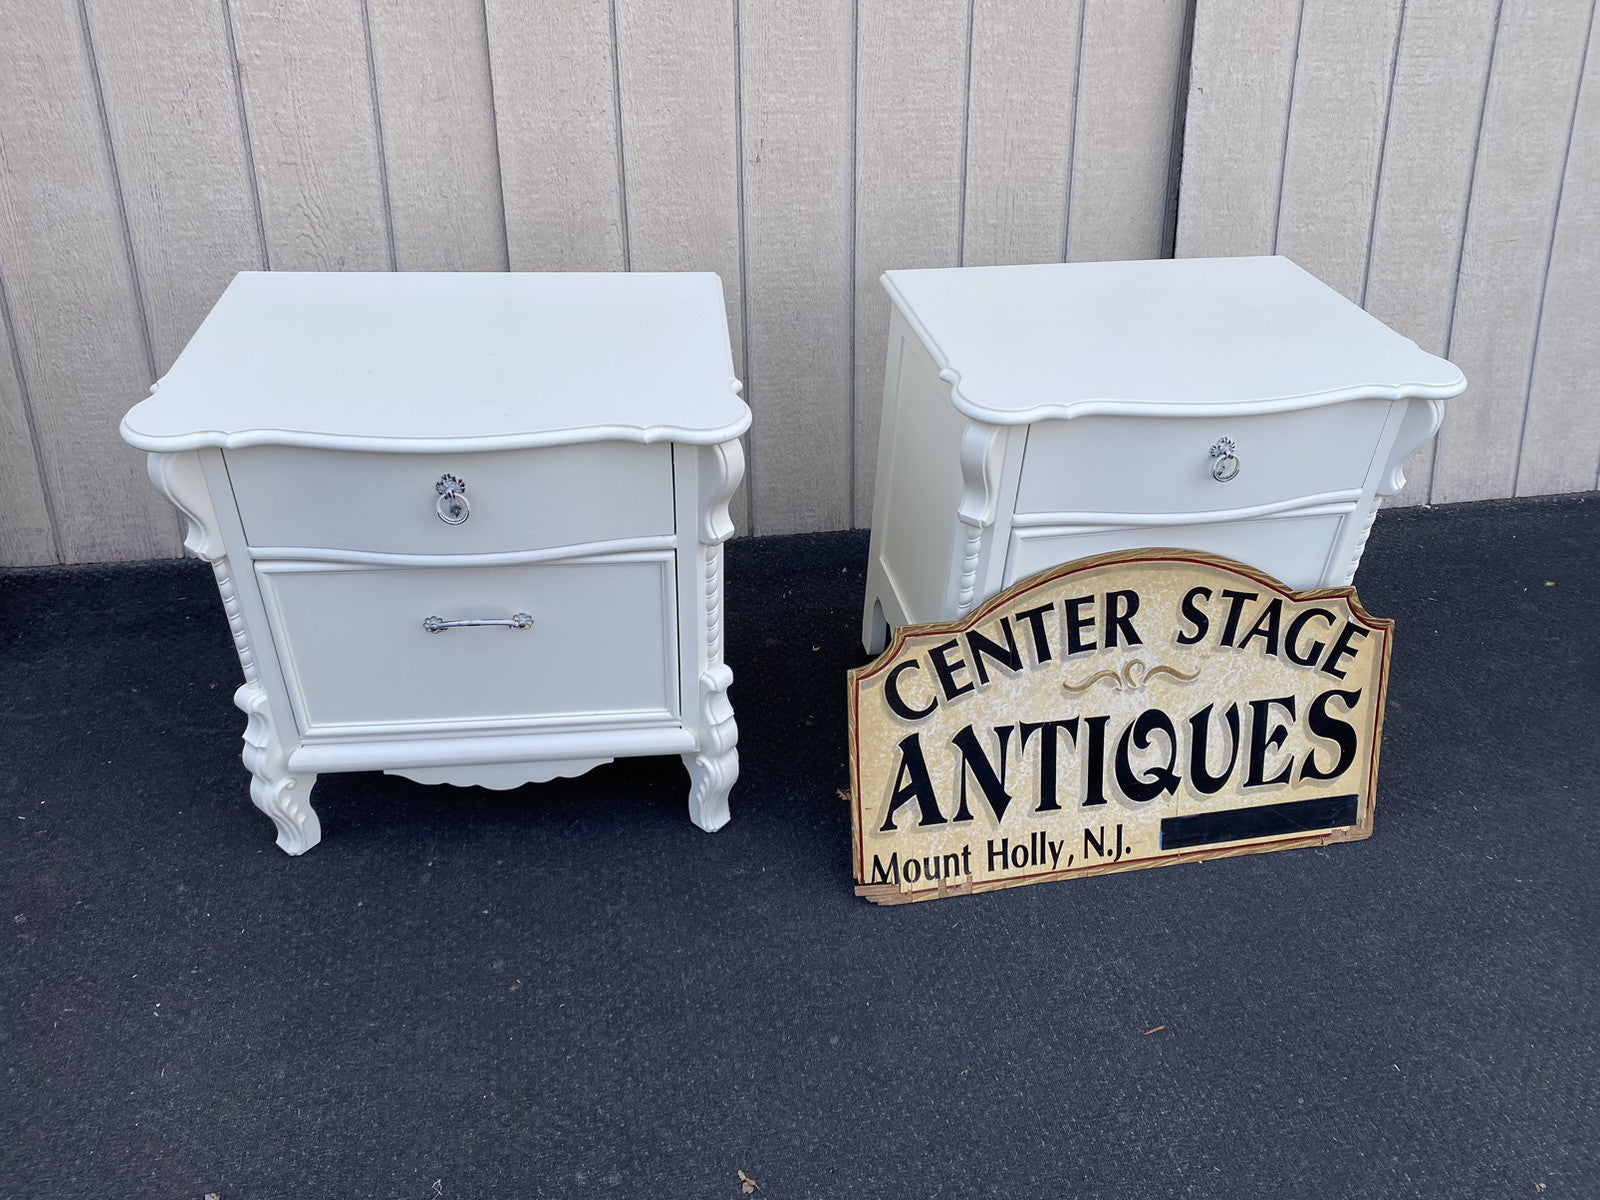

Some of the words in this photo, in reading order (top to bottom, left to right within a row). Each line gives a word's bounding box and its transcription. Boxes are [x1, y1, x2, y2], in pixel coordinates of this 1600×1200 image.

[884, 589, 1143, 720] CENTER
[1176, 587, 1371, 680] STAGE
[879, 688, 1363, 832] ANTIQUES
[871, 844, 972, 885] Mount
[987, 831, 1074, 872] Holly,
[1083, 823, 1132, 863] N.J.
